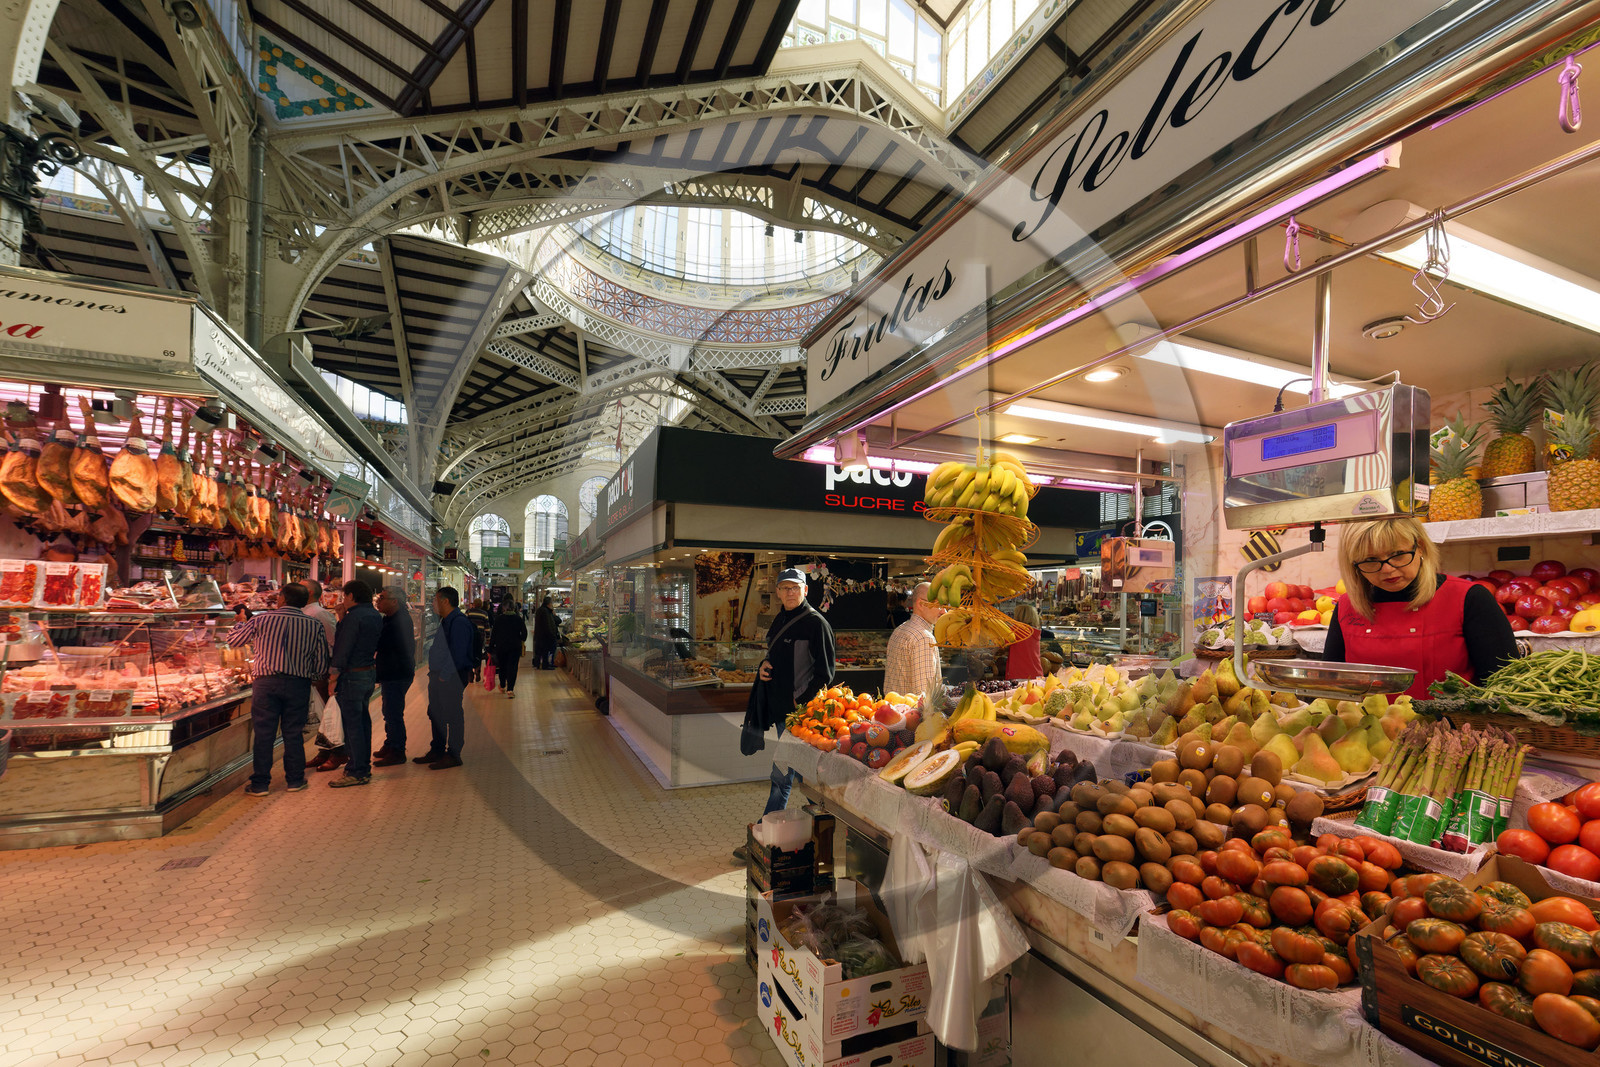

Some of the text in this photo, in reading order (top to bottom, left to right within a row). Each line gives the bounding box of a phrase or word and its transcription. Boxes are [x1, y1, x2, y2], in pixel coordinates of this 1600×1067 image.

[821, 258, 956, 382] Frutas
[162, 349, 176, 358] 69
[201, 352, 244, 391] Jamones
[825, 464, 913, 491] paco
[824, 494, 928, 513] SUCRE &
